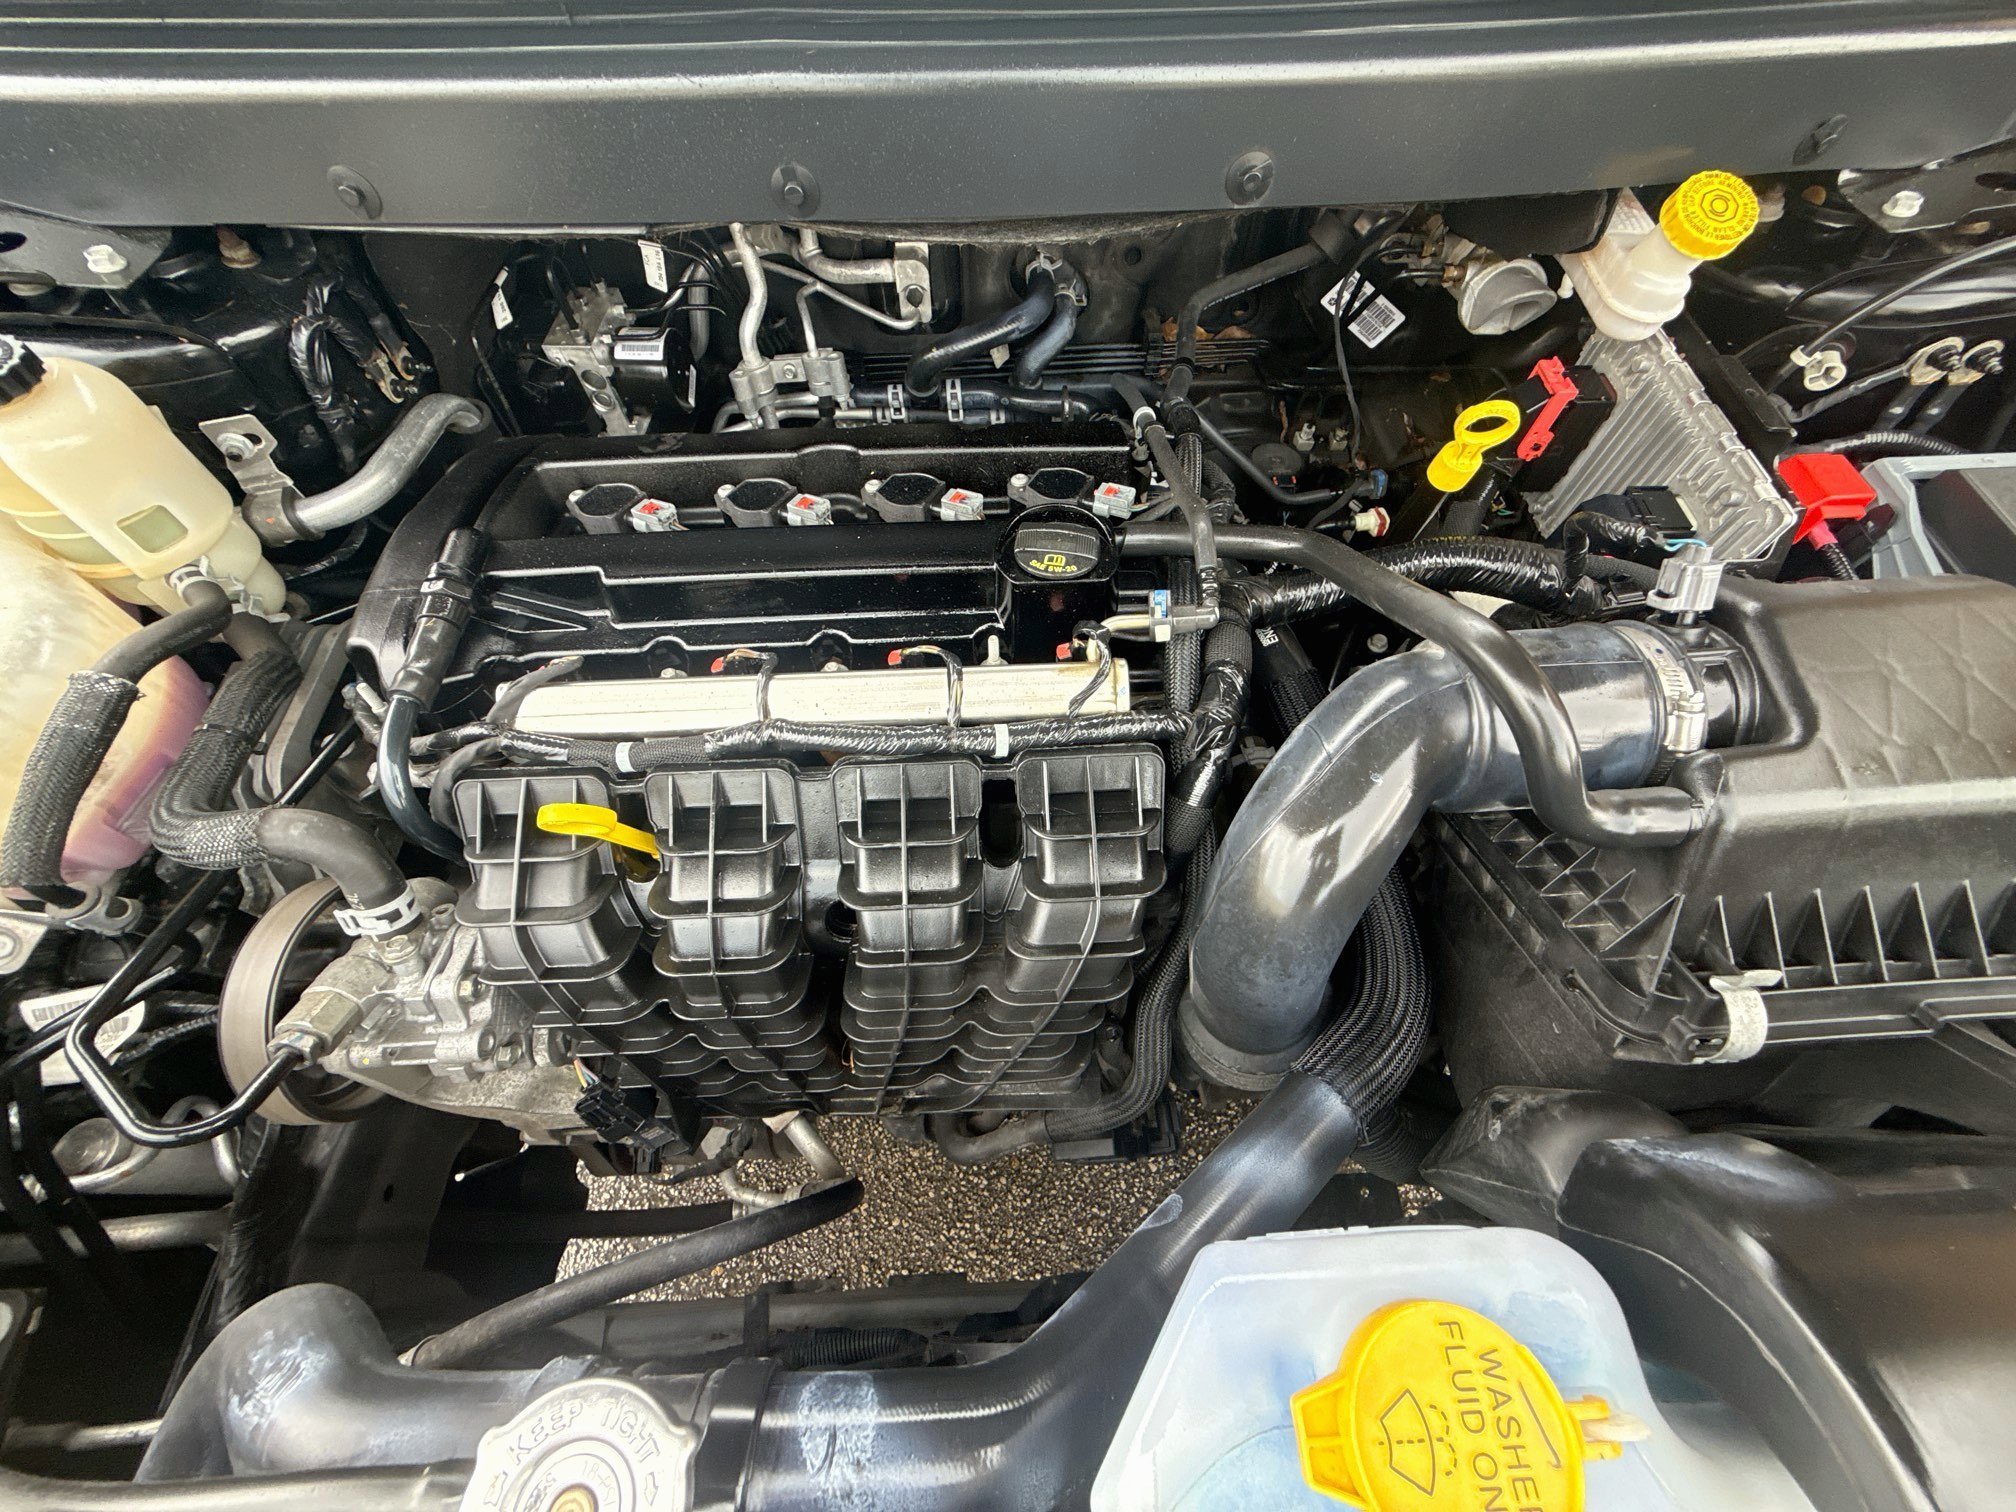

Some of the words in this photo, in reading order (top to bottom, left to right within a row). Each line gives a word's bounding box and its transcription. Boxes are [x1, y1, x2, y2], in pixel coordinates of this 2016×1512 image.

[1029, 559, 1047, 570] SAE
[1047, 564, 1078, 573] 5W-20
[1438, 1320, 1486, 1435] FLUID
[507, 1399, 584, 1467] KEEP
[601, 1396, 662, 1464] TIGHT
[1477, 1347, 1545, 1512] WASHE
